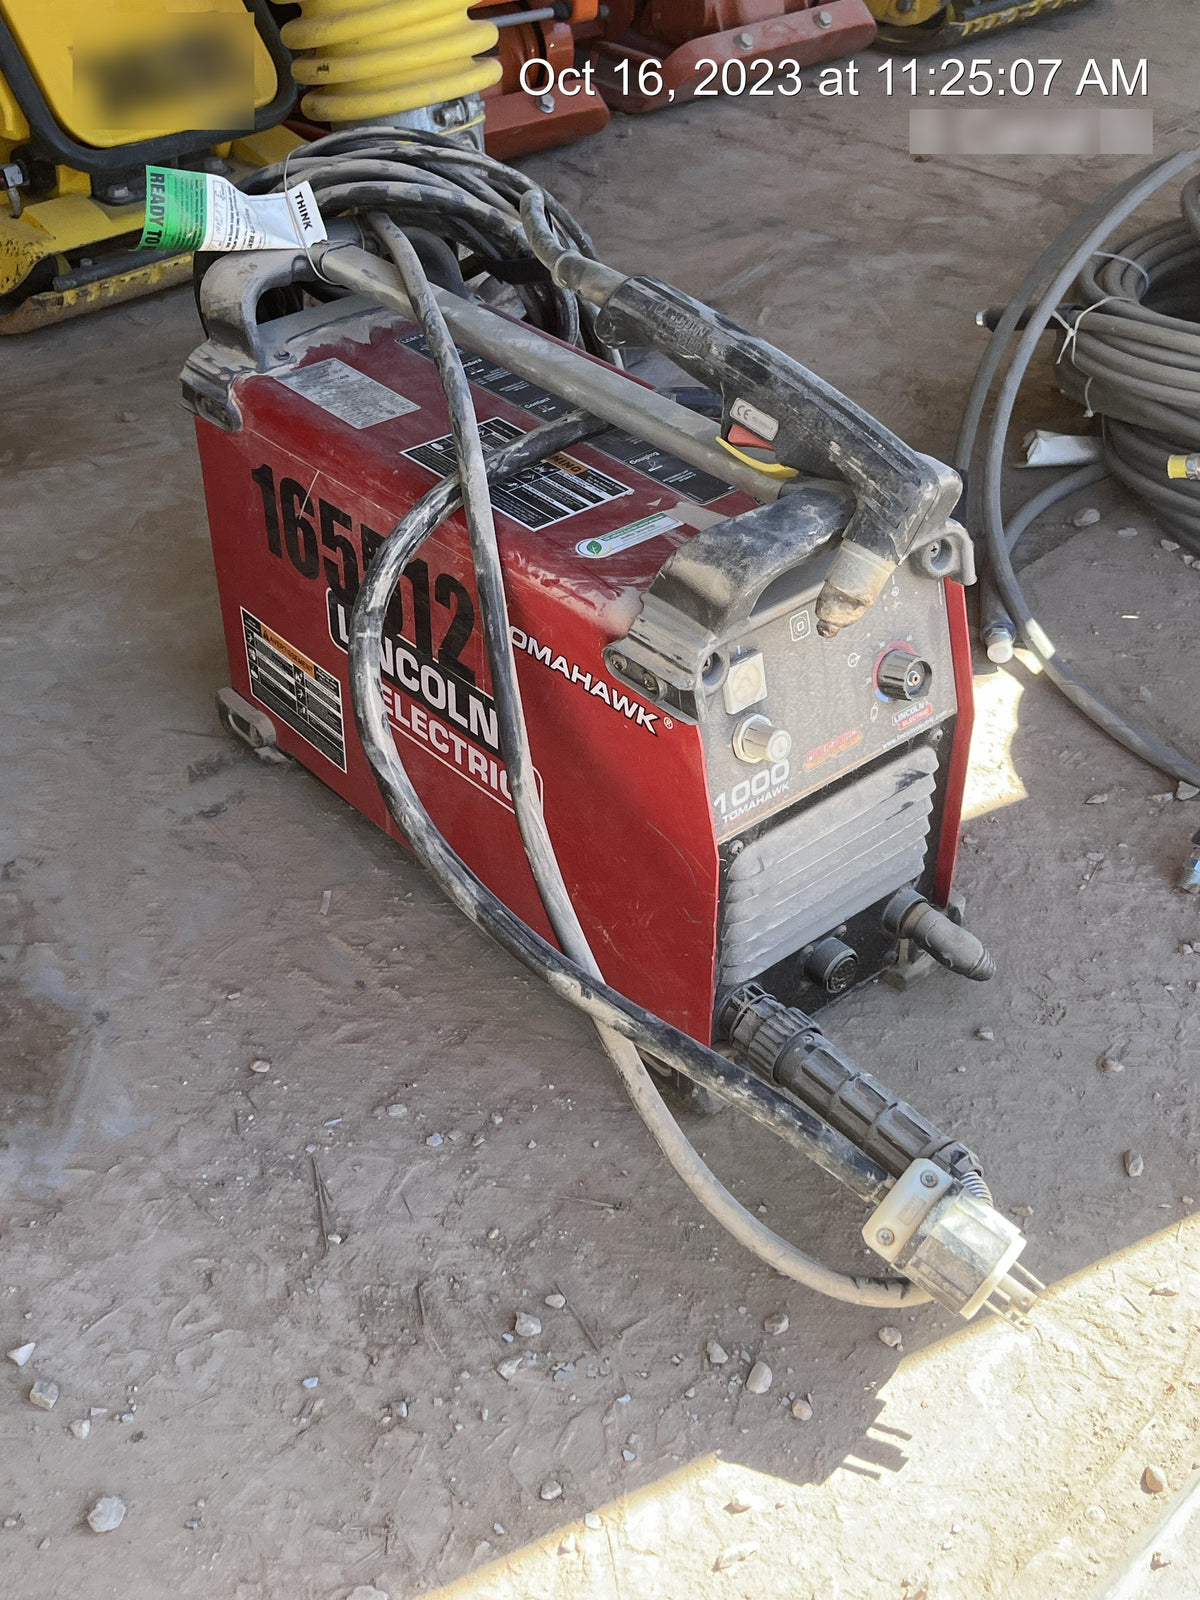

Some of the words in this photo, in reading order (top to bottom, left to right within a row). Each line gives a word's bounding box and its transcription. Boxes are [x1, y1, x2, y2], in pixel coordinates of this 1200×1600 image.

[149, 172, 166, 227] READY
[294, 191, 313, 231] THINK
[145, 229, 163, 245] TO
[524, 397, 551, 409] Contact
[550, 454, 583, 473] NING
[337, 603, 499, 751] LNCOLN
[509, 625, 658, 736] OMAHAWK
[893, 701, 926, 724] LINCOLN
[713, 758, 790, 815] 1000
[721, 781, 790, 824] TOMAHAWK
